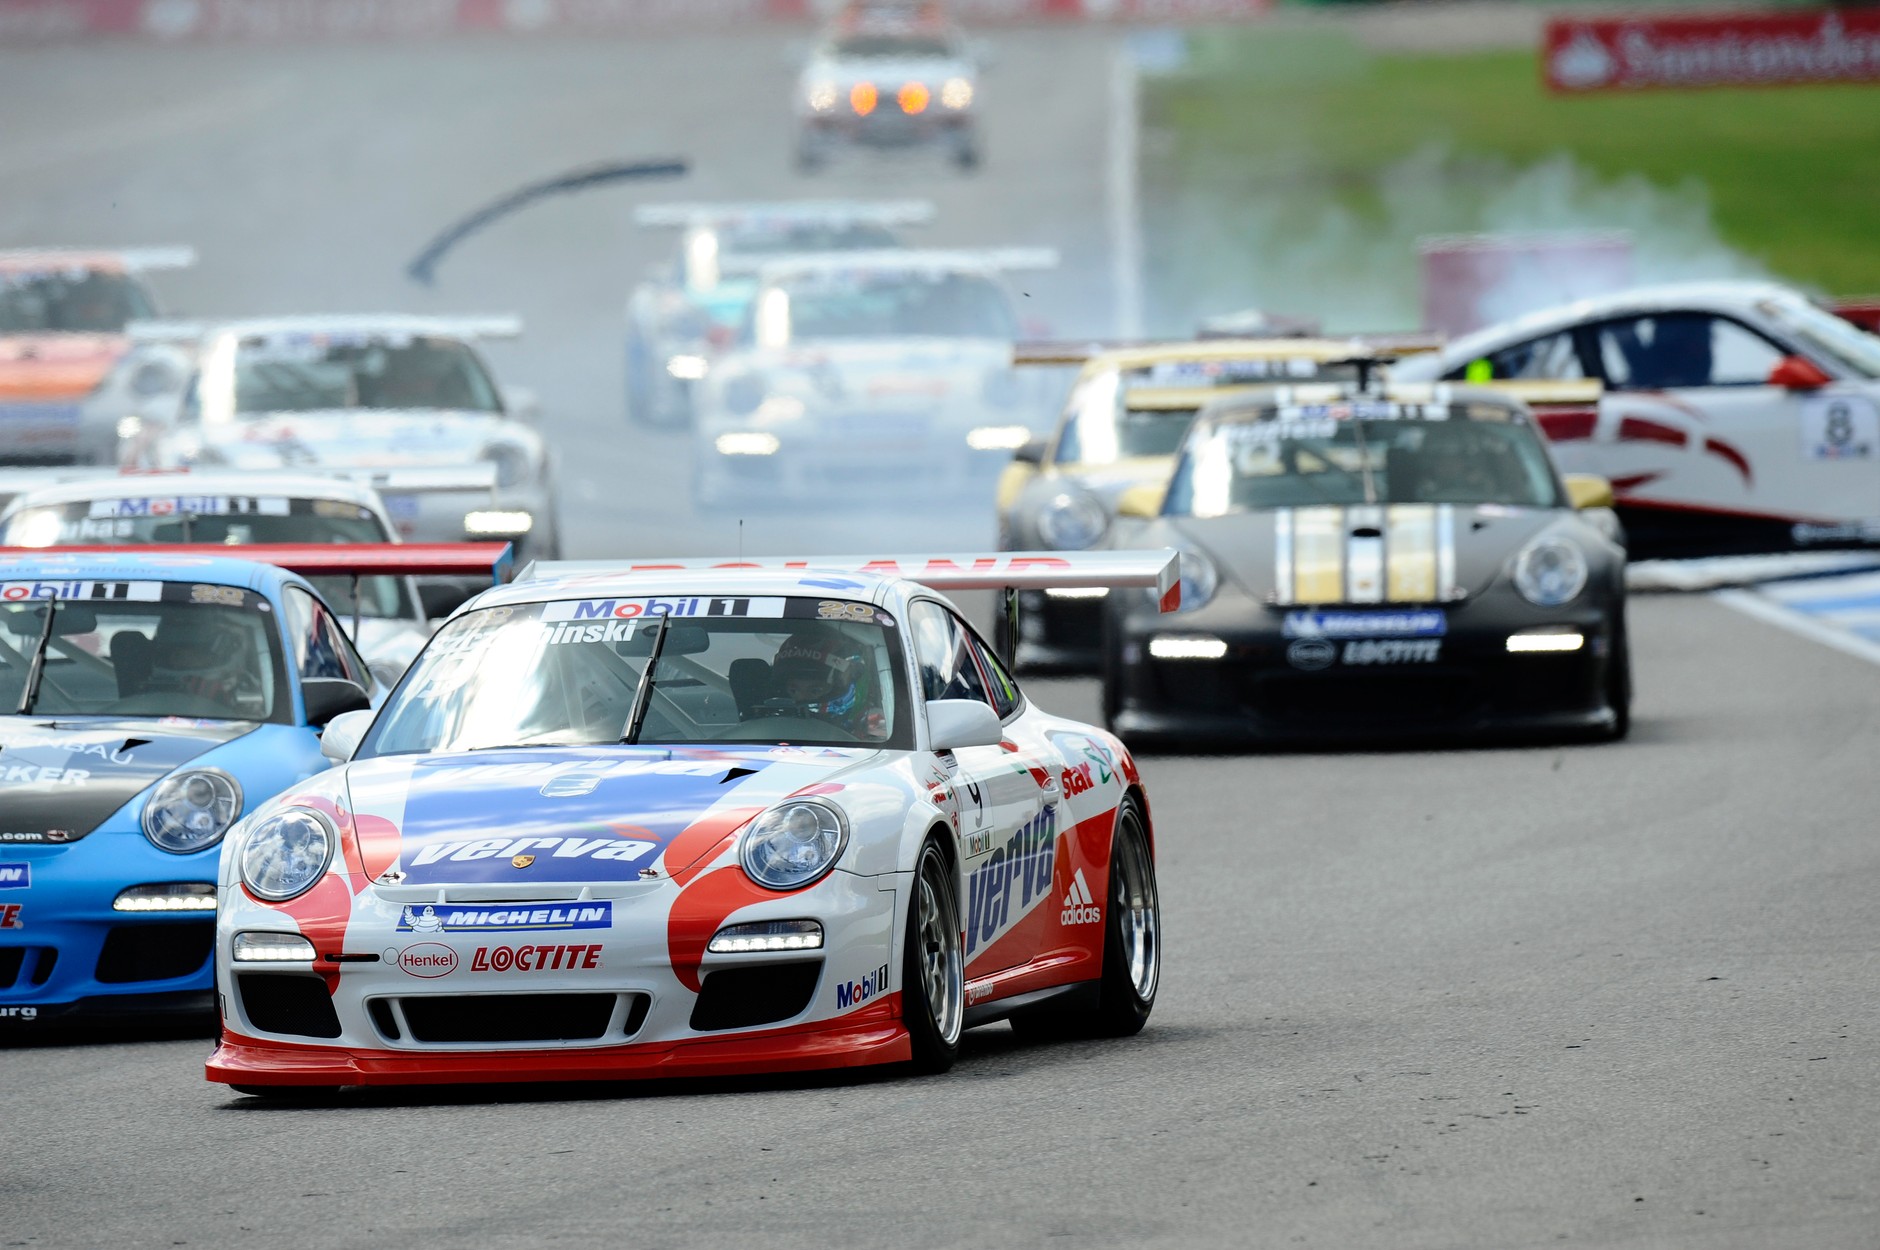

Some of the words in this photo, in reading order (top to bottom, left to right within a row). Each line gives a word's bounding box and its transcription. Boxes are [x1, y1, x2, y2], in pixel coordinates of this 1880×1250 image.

[1826, 402, 1852, 446] 8
[119, 496, 218, 515] Mobil
[0, 582, 82, 602] obil
[574, 598, 697, 618] Mobil
[818, 601, 874, 617] 20
[1061, 761, 1094, 800] star
[962, 771, 984, 828] 9
[410, 836, 657, 867] verva
[966, 804, 1056, 957] verva
[447, 907, 606, 926] MICHELIN
[1061, 902, 1101, 926] adidas
[403, 953, 454, 967] Henkel
[470, 945, 603, 972] LOCTITE
[837, 970, 877, 1009] Mobil
